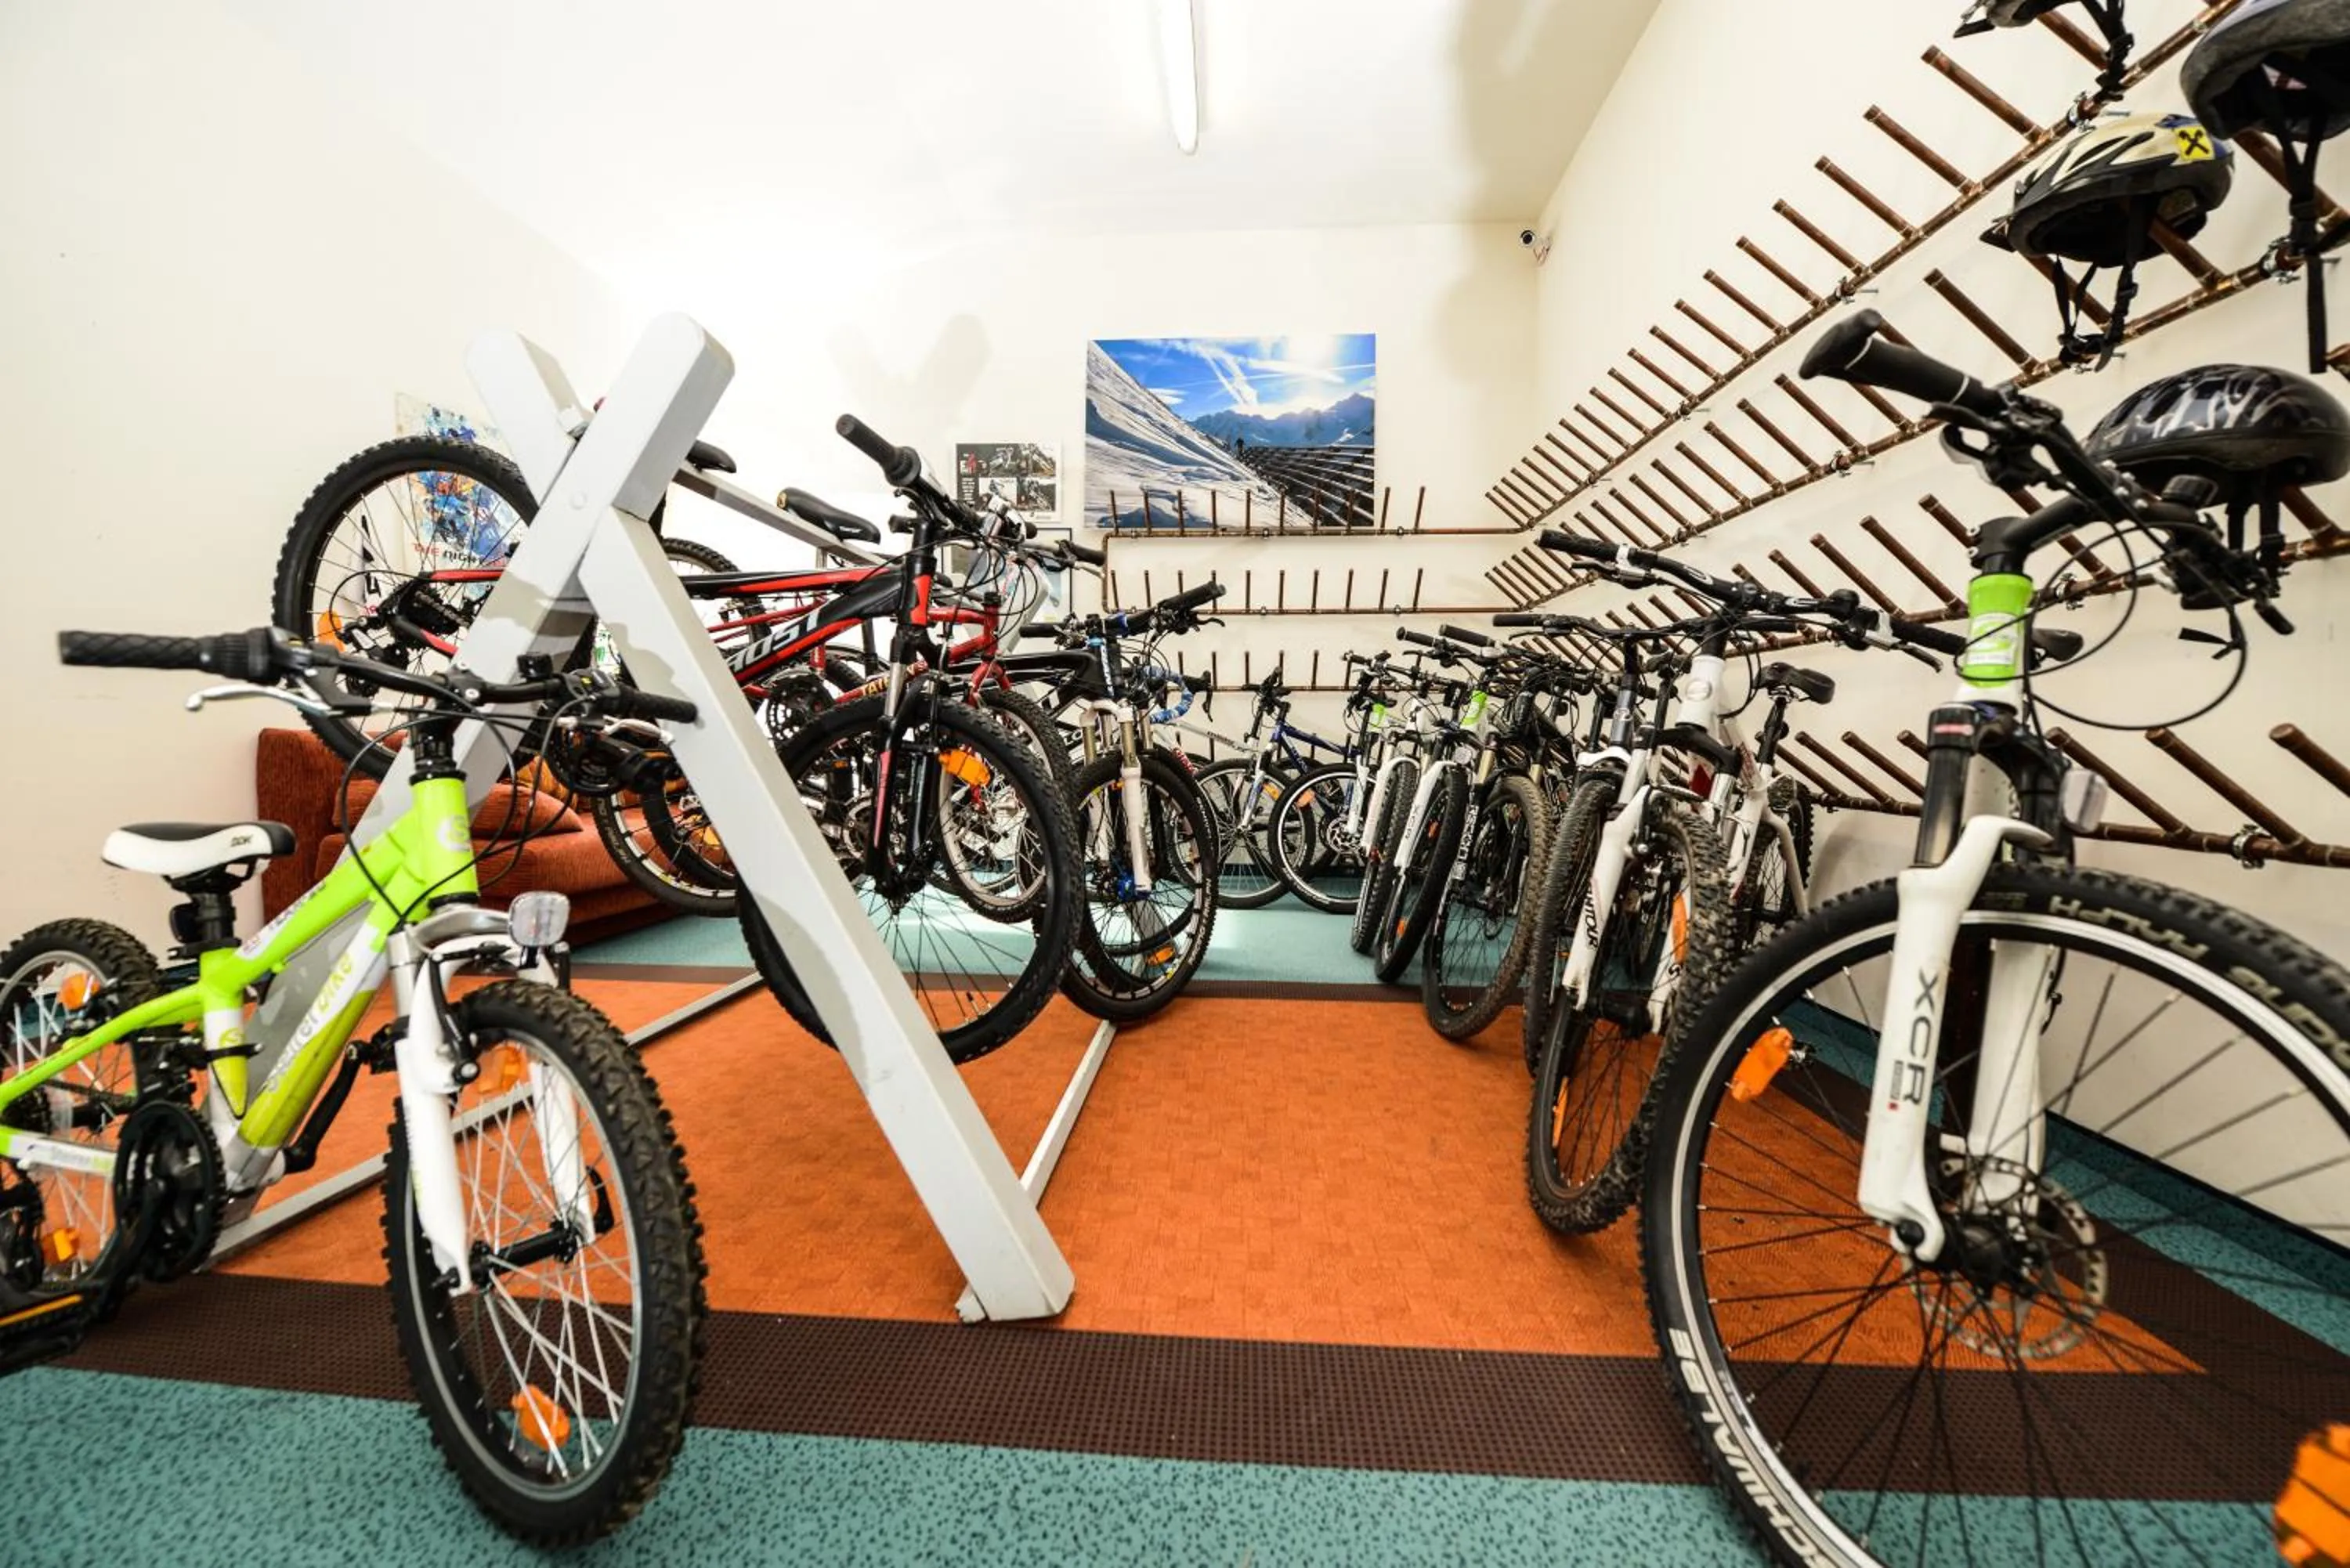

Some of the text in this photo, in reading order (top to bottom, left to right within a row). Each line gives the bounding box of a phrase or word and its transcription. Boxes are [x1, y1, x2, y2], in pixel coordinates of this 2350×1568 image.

[727, 608, 820, 673] HOST
[2049, 894, 2209, 960] RALPH
[1903, 968, 1939, 1105] XCR
